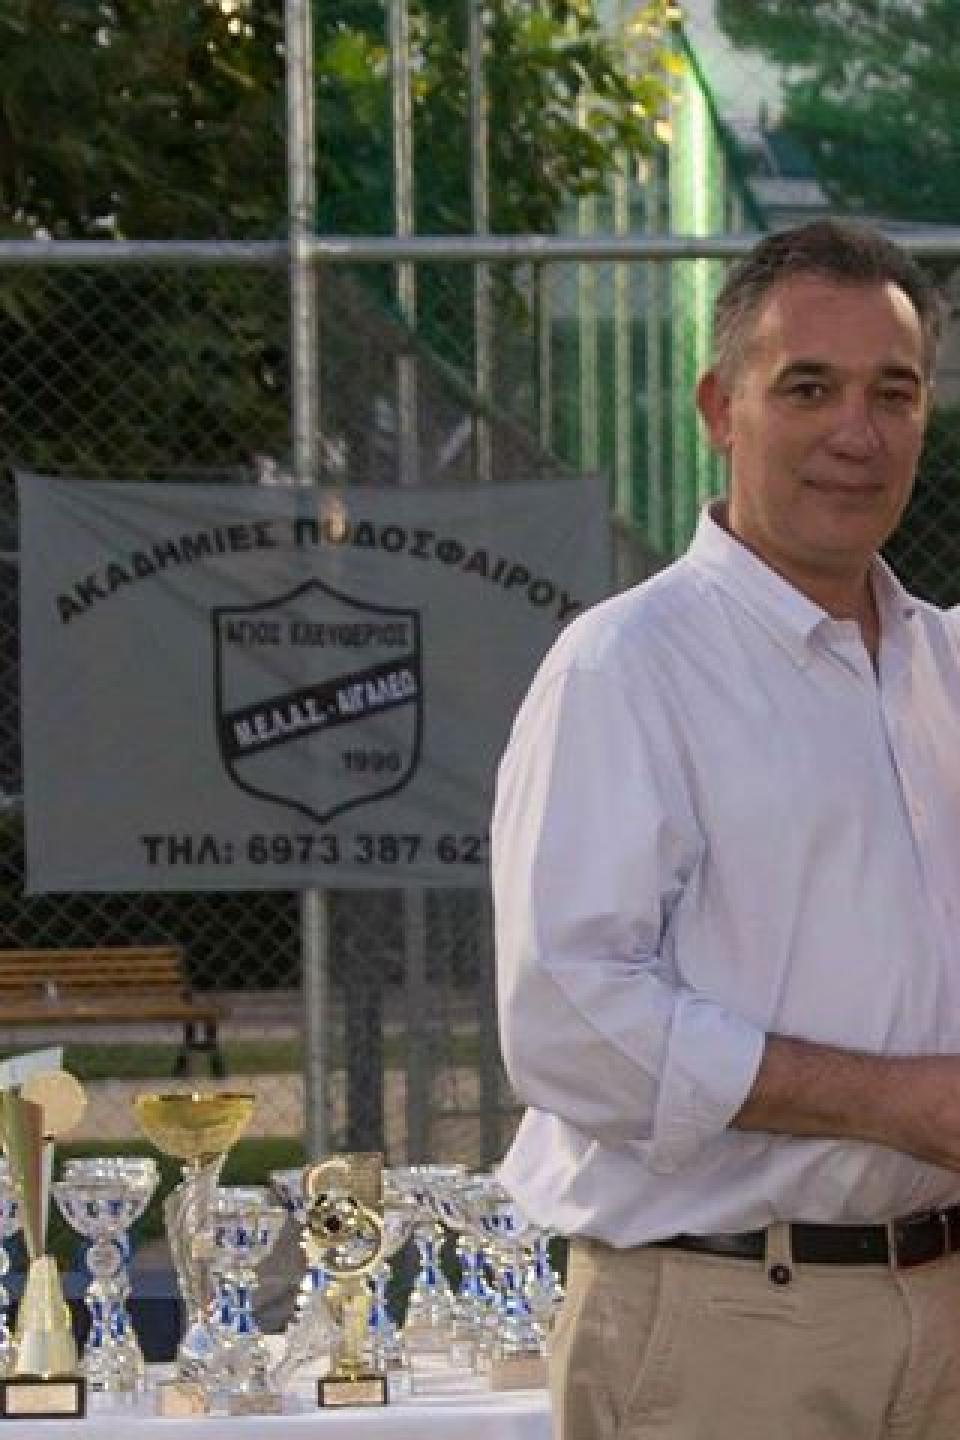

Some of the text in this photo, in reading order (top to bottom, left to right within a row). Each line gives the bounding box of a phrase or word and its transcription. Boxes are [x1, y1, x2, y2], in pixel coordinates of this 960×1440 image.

[56, 521, 278, 624] ΑΚΑΔΗΜΙΕΣ
[142, 834, 235, 865] ΤΗΛ:
[247, 834, 340, 865] 6973
[355, 834, 422, 865] 387
